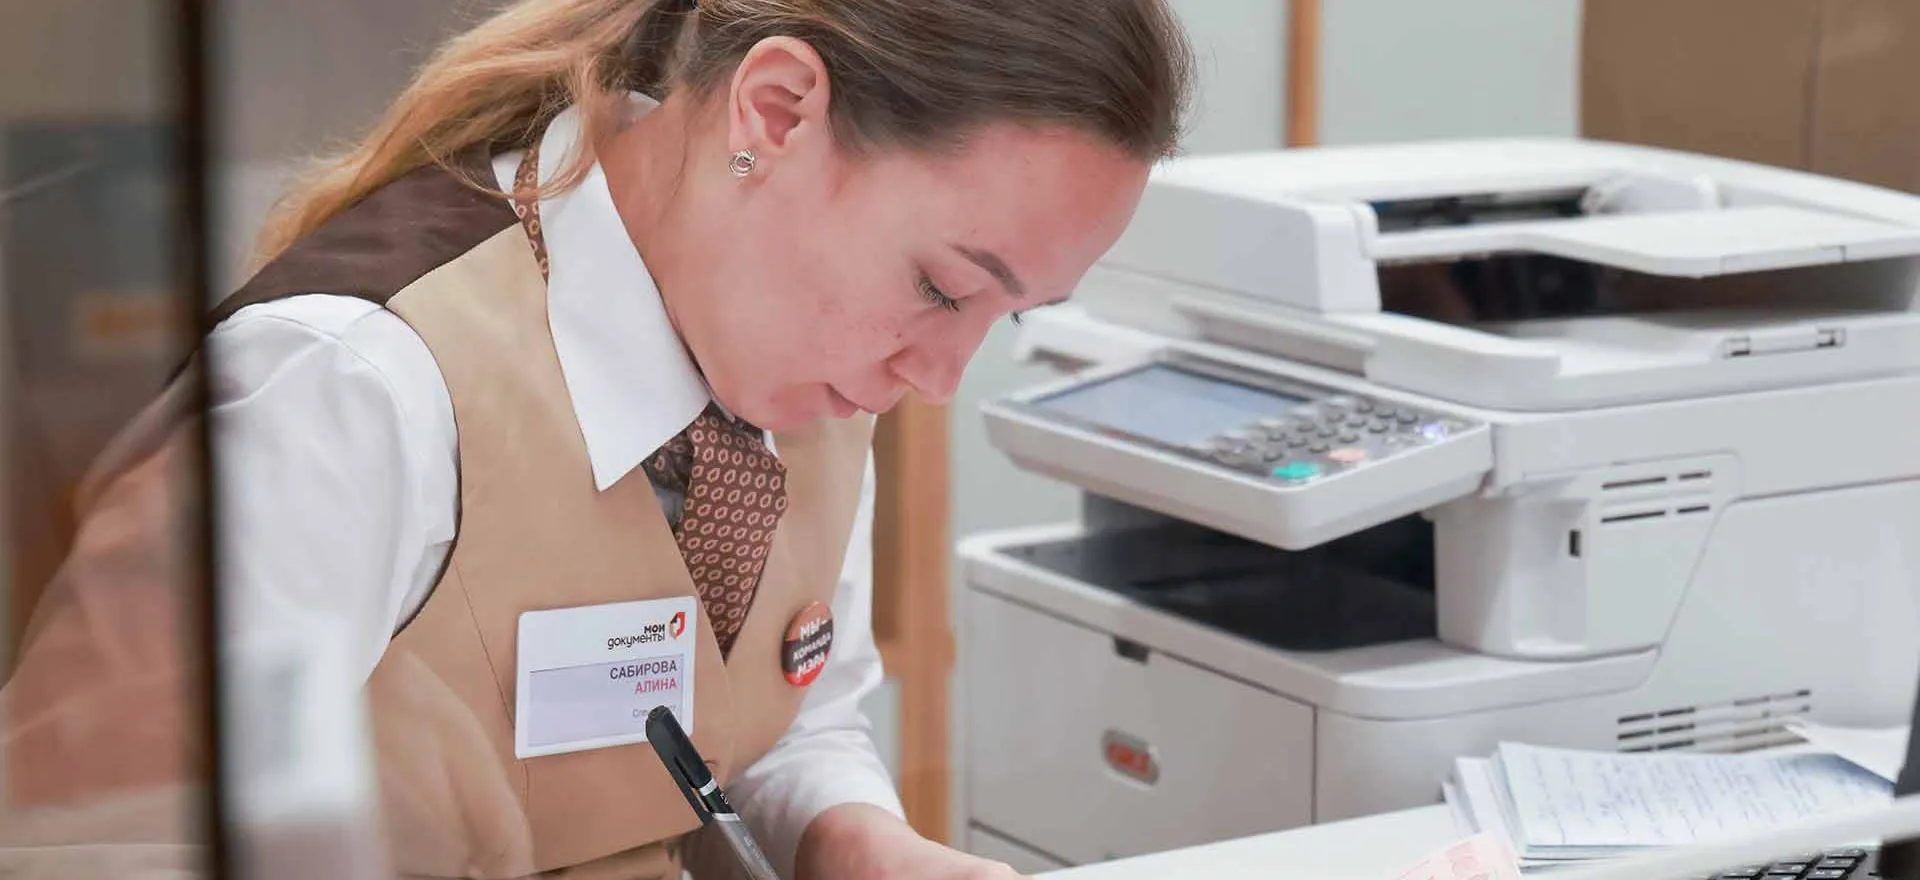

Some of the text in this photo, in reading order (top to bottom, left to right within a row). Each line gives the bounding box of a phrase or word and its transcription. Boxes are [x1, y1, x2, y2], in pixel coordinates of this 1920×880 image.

[792, 632, 831, 662] КОМАНДА
[610, 660, 677, 679] САБИРОВА
[797, 651, 825, 678] МЭРА
[634, 678, 677, 695] АЛИНА
